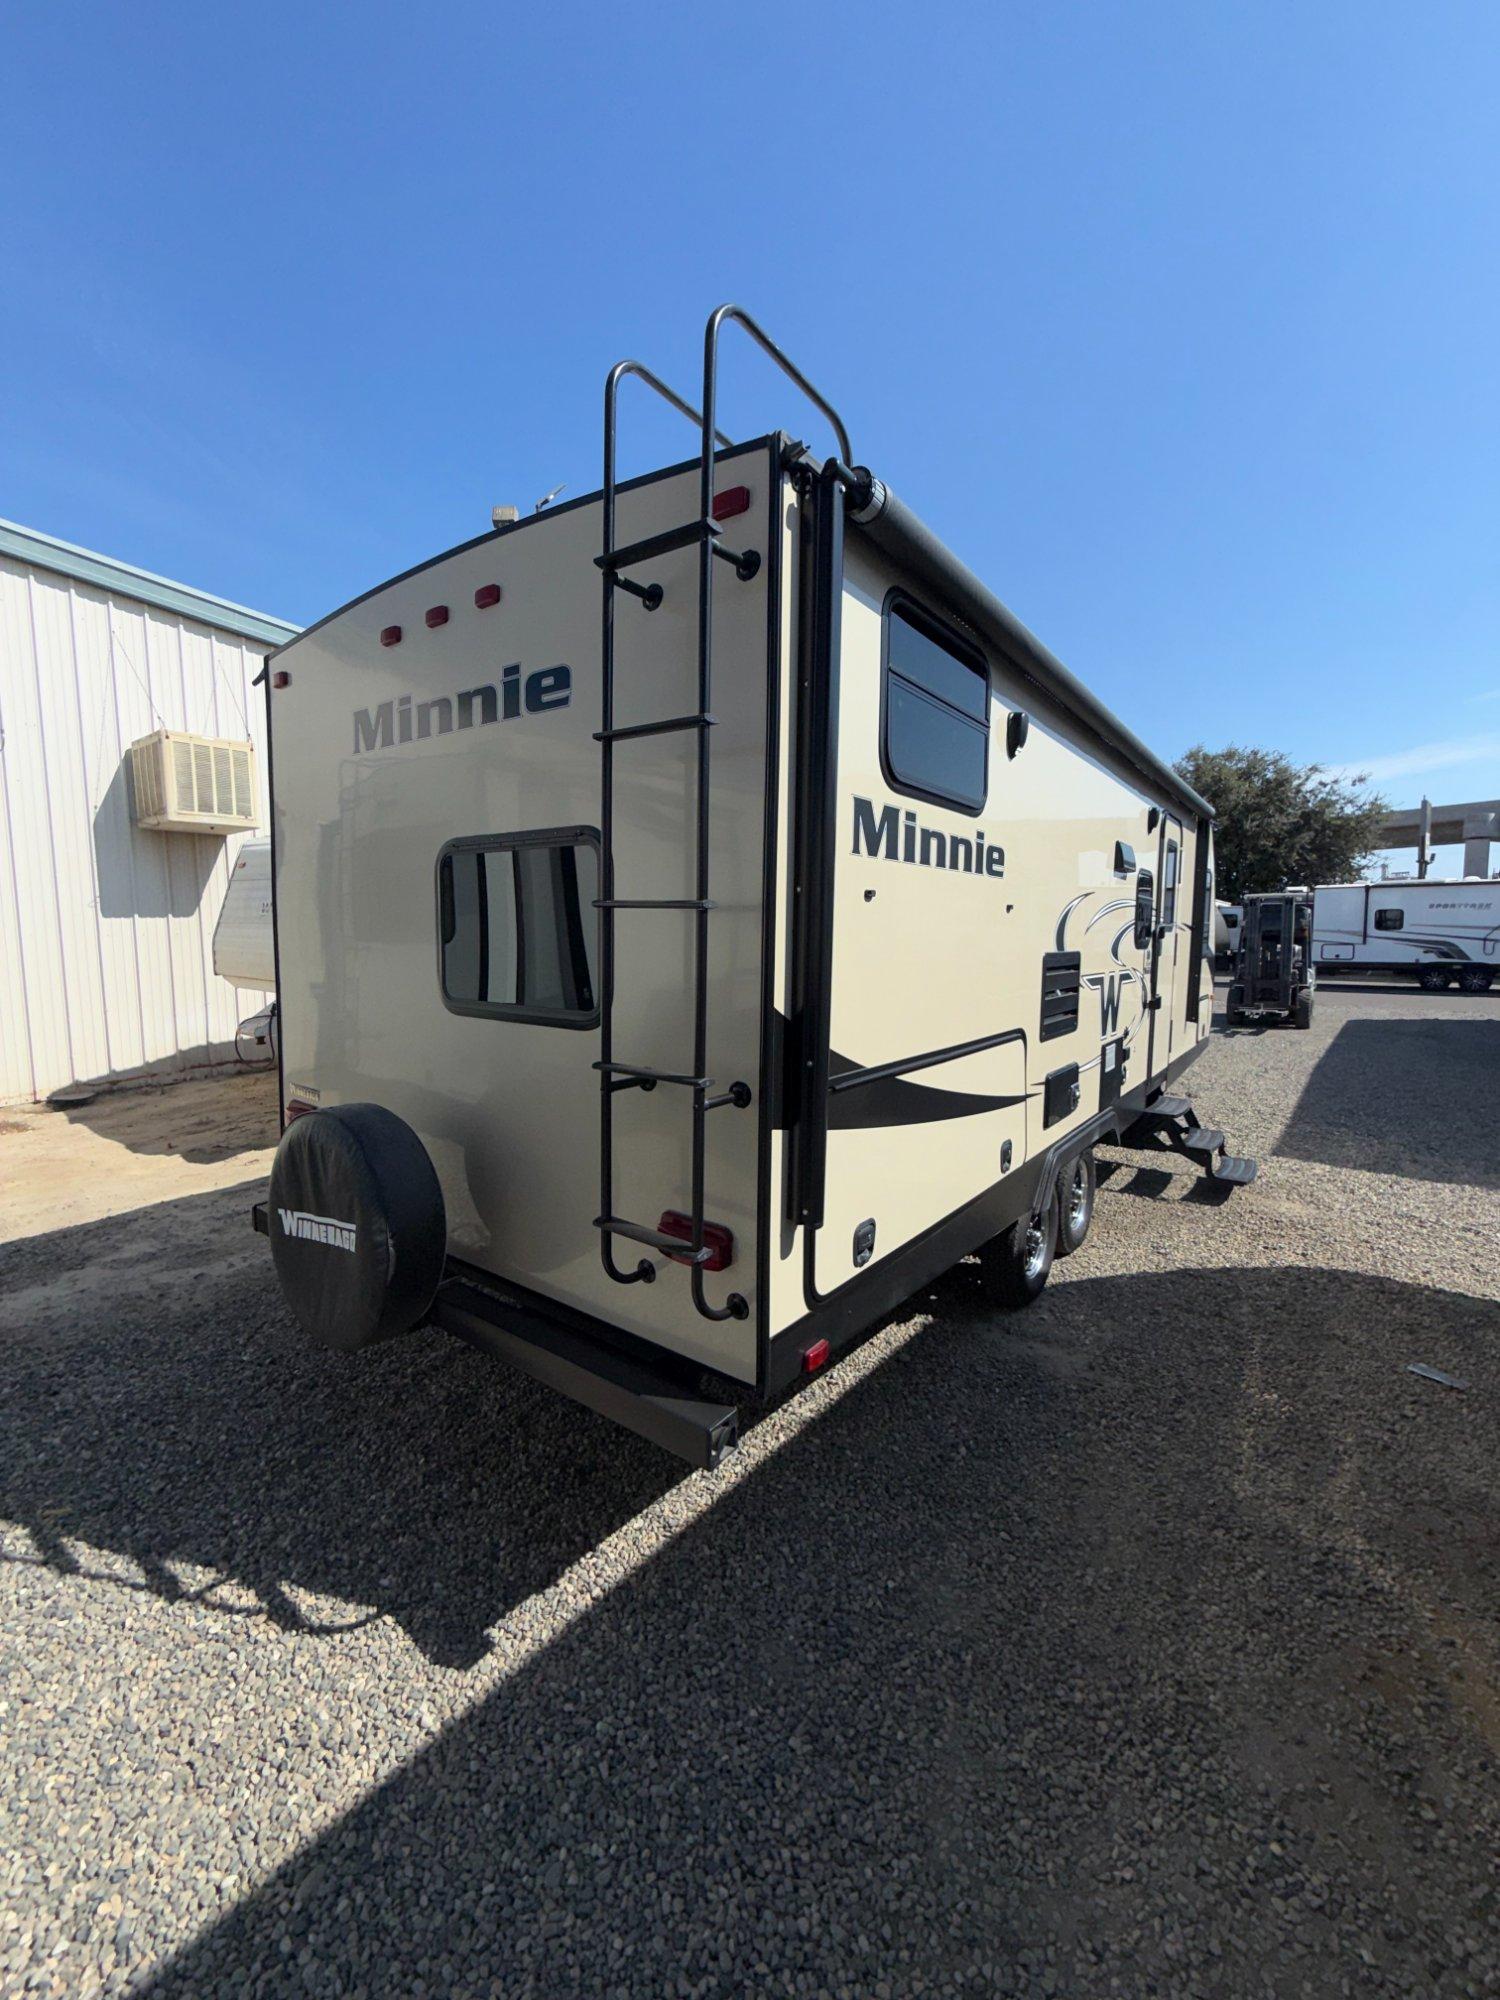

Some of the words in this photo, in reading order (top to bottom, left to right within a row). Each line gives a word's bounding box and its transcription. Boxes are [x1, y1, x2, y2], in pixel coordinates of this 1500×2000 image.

[352, 663, 572, 754] Minnie
[851, 795, 1005, 878] Minnie
[278, 1208, 357, 1253] WINNEBAGO
